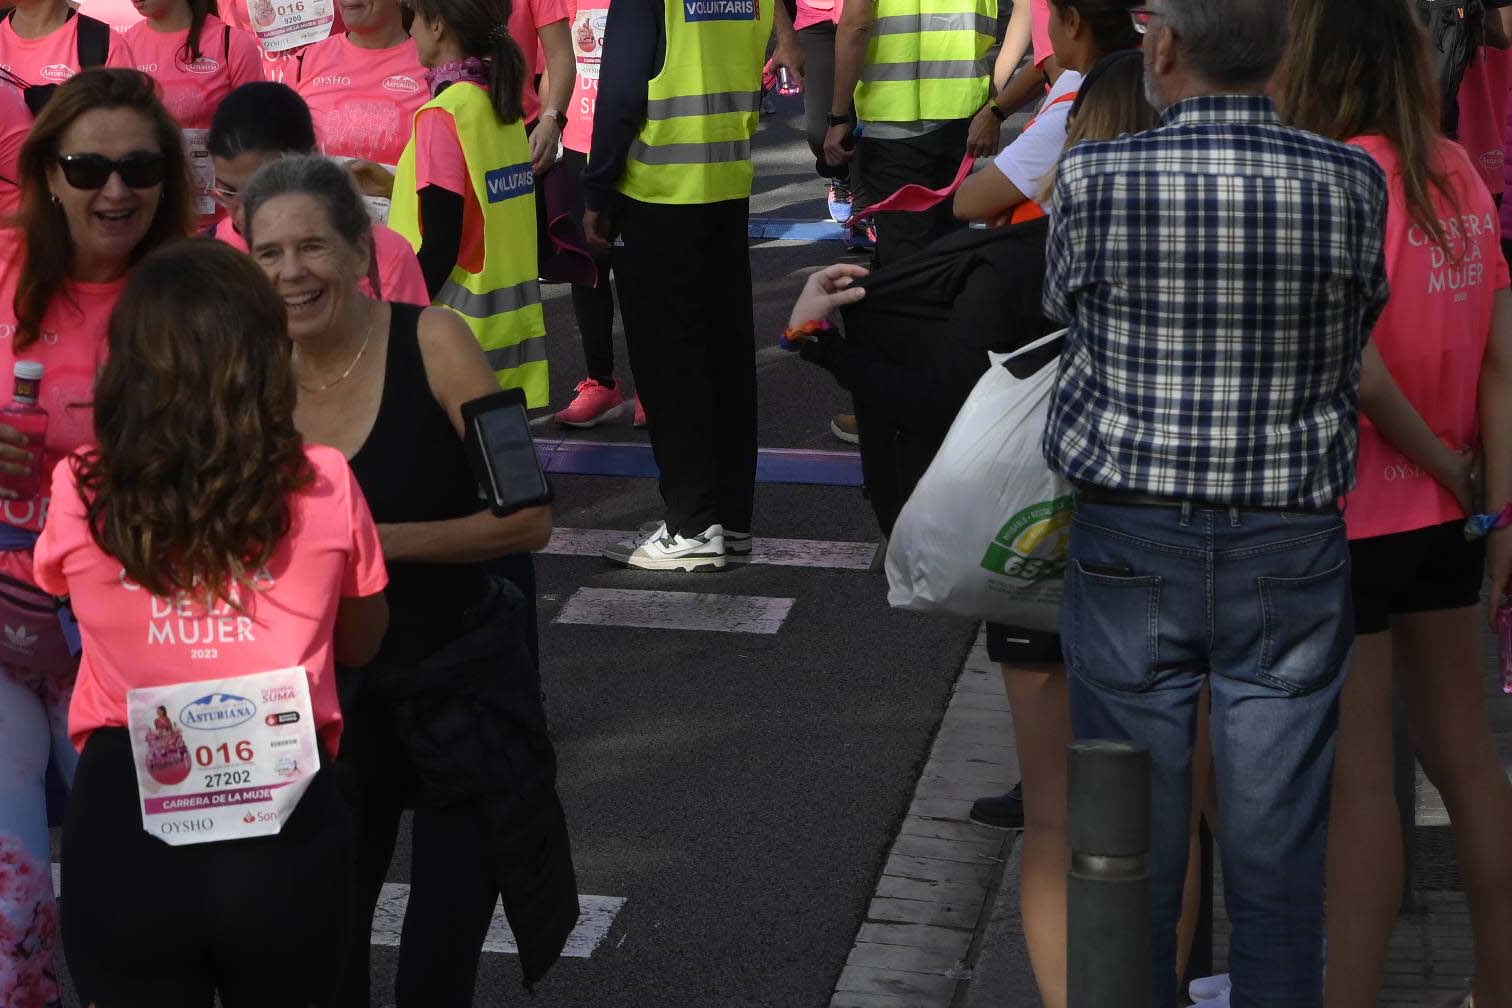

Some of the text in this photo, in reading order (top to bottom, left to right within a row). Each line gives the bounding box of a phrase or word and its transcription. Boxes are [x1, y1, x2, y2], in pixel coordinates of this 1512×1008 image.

[277, 1, 305, 17] 016
[686, 0, 753, 15] VOLUNTARIS
[284, 14, 302, 25] 9200
[313, 76, 351, 86] OYSHO
[1428, 263, 1484, 293] MUJER
[151, 590, 193, 618] DE
[147, 616, 256, 645] MUJER
[190, 648, 219, 659] 2023
[187, 690, 297, 725] ASTURIANA SUMA
[194, 740, 255, 767] 016
[204, 770, 252, 788] 27202
[162, 794, 211, 810] CARRERA
[211, 793, 226, 805] DE
[227, 791, 241, 802] LA
[160, 817, 215, 835] OYSHO
